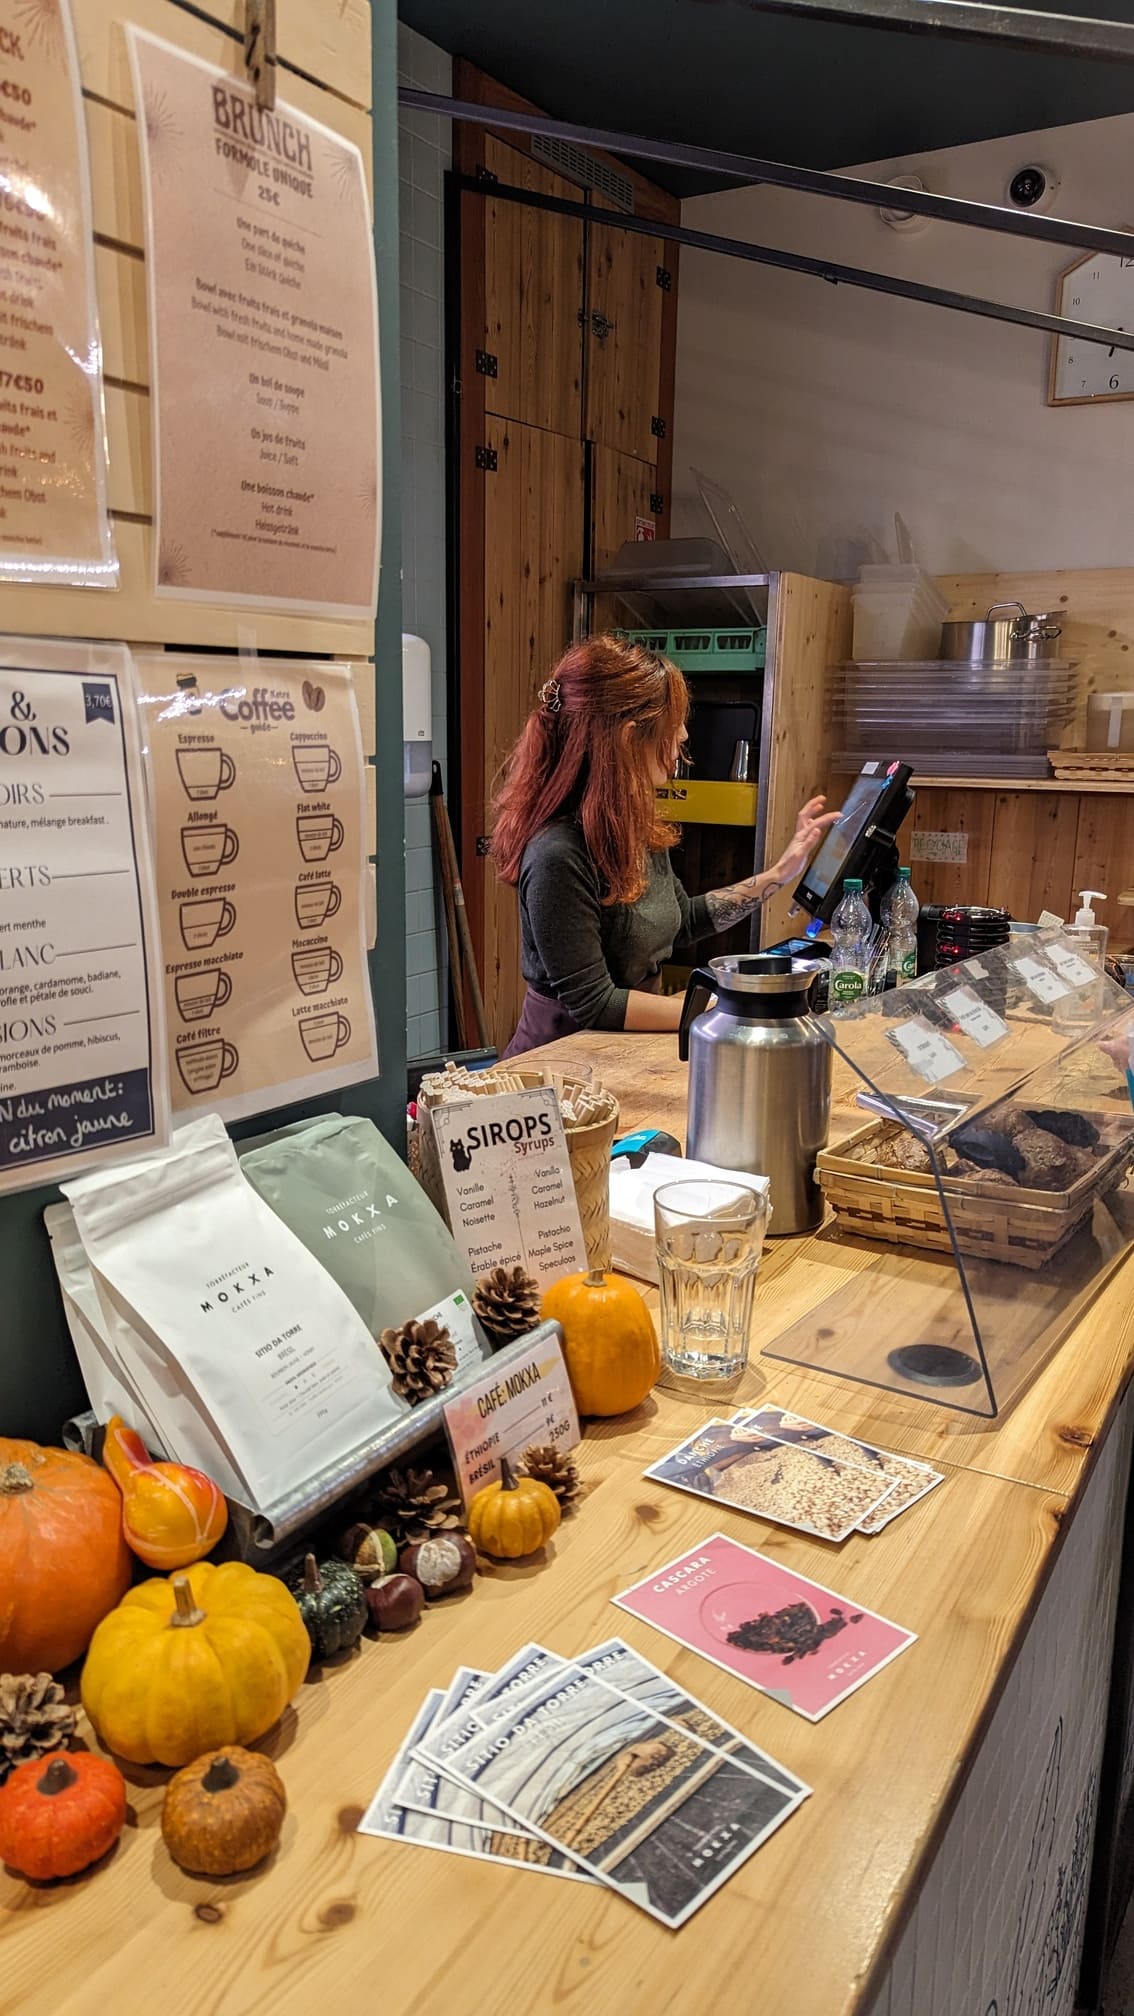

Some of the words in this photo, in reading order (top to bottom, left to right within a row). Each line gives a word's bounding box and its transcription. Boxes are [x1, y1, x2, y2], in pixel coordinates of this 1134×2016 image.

[211, 84, 313, 172] BRUNCH
[258, 185, 280, 206] 25€
[1072, 297, 1081, 306] 10
[1109, 374, 1119, 390] 6
[240, 480, 256, 493] Une
[10, 691, 38, 722] &
[85, 695, 113, 709] 3,70€
[220, 688, 295, 720] Coffee
[178, 734, 215, 745] Espresso
[290, 732, 328, 743] Cappuccino
[187, 811, 218, 823] Allongé
[297, 803, 310, 814] Flat
[311, 802, 330, 811] white
[30, 816, 66, 829] mélange
[68, 815, 105, 827] breakfast
[298, 871, 313, 882] Café
[314, 869, 332, 880] latte
[171, 885, 199, 900] Double
[201, 883, 236, 896] espresso
[13, 919, 47, 932] menthe
[165, 960, 202, 975] Espresso
[203, 951, 244, 965] macchiato
[34, 976, 86, 992] cardamome,
[87, 970, 121, 982] badiane,
[834, 979, 862, 992] Carola
[19, 996, 28, 1005] et
[30, 990, 56, 1006] pétale
[58, 988, 69, 998] de
[70, 986, 94, 997] souci.
[292, 1005, 312, 1017] Latte
[313, 997, 348, 1011] macchiato
[0, 1015, 57, 1043] IONS
[176, 1033, 197, 1045] Café
[197, 1027, 221, 1040] filtre
[41, 1045, 52, 1055] de
[53, 1041, 87, 1053] pomme,
[87, 1033, 121, 1046] hibiscus,
[17, 1098, 45, 1119] du
[9, 1124, 67, 1153] citron
[70, 1111, 133, 1147] jaune
[466, 1113, 552, 1150] SIROPS
[514, 1136, 555, 1157] Syrups
[535, 1167, 561, 1179] Vanilla
[456, 1183, 485, 1197] Vanille
[531, 1180, 564, 1195] Caramel
[459, 1196, 495, 1212] Caramel
[533, 1196, 566, 1210] Hazelnut
[322, 1194, 398, 1240] MOKXA
[462, 1213, 496, 1228] Noisette
[538, 1225, 571, 1240] Pistachio
[468, 1241, 502, 1257] Pistache
[528, 1246, 553, 1262] Maple
[553, 1239, 574, 1255] Spice
[471, 1258, 498, 1274] Érable
[499, 1253, 522, 1269] épicé
[539, 1255, 576, 1272] Speculoos
[200, 1266, 274, 1313] MOKXA
[506, 1362, 542, 1398] MOKXA
[549, 1420, 571, 1443] 250G
[465, 1431, 501, 1465] ÉTHIOPIE
[468, 1458, 496, 1486] BRÉSIL
[653, 1557, 711, 1592] CASCARA
[676, 1568, 716, 1595] ARGOTE
[581, 1651, 624, 1676] ORRE
[467, 1735, 511, 1771] SITIO
[512, 1719, 532, 1736] DA
[540, 1679, 587, 1717] TORRE
